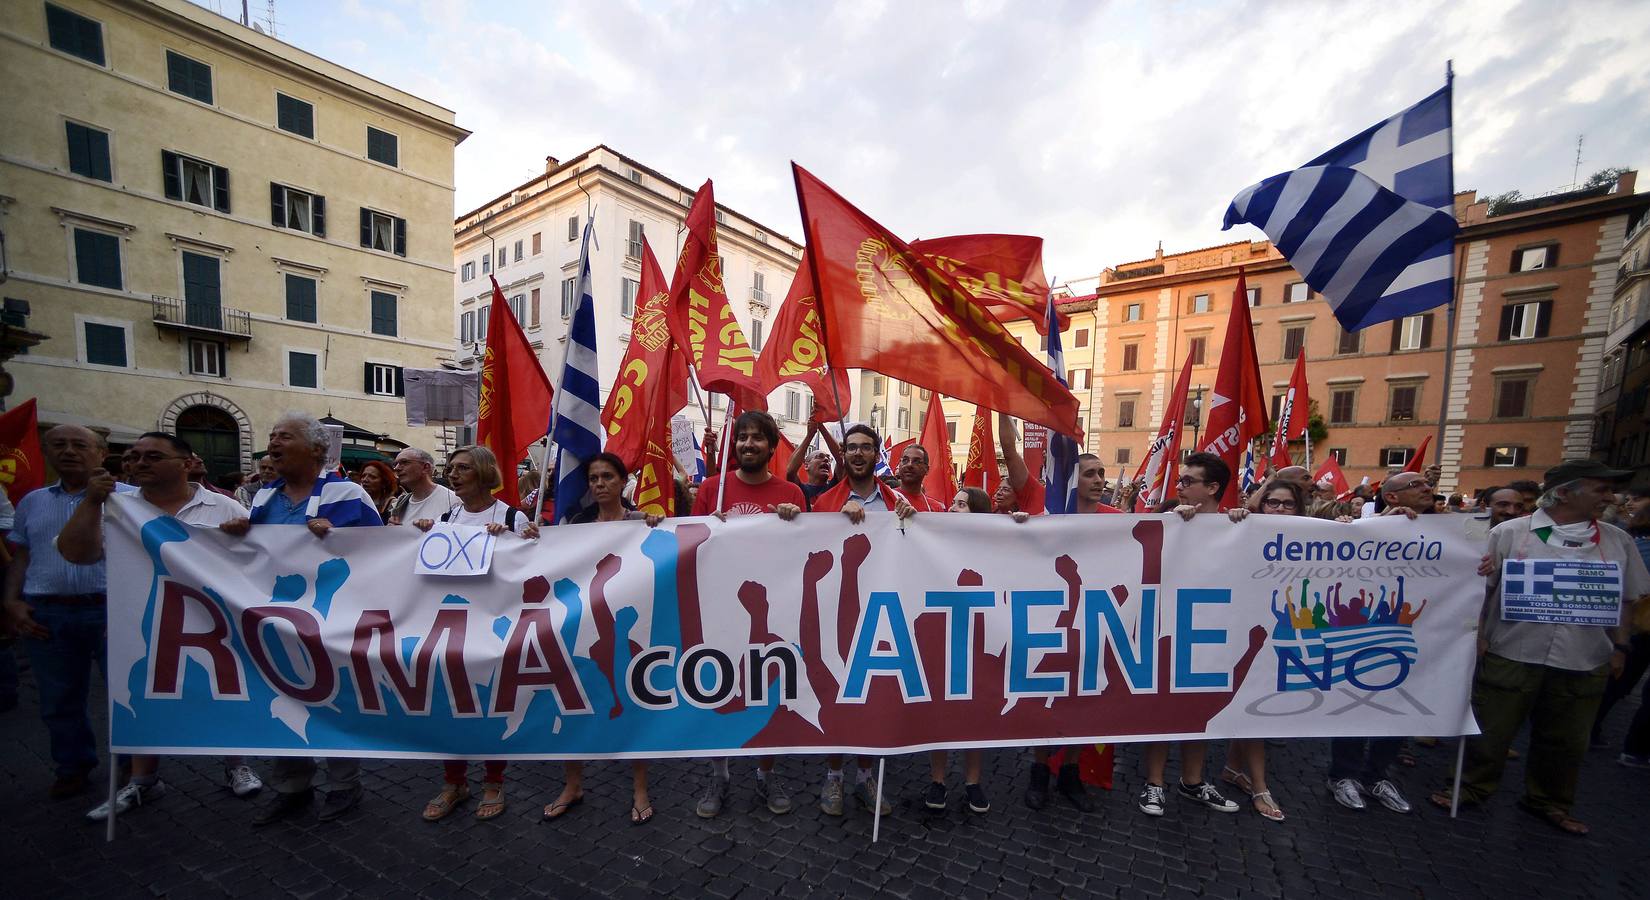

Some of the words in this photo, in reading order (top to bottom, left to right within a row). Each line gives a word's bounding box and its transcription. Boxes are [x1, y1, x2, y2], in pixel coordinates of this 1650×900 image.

[421, 532, 492, 570] OXI
[1262, 533, 1443, 562] demoGrecia
[1577, 569, 1605, 577] SIAMO
[146, 579, 594, 714] ROMA
[631, 645, 798, 707] con
[842, 588, 1232, 700] ATENE
[1276, 646, 1411, 692] NO
